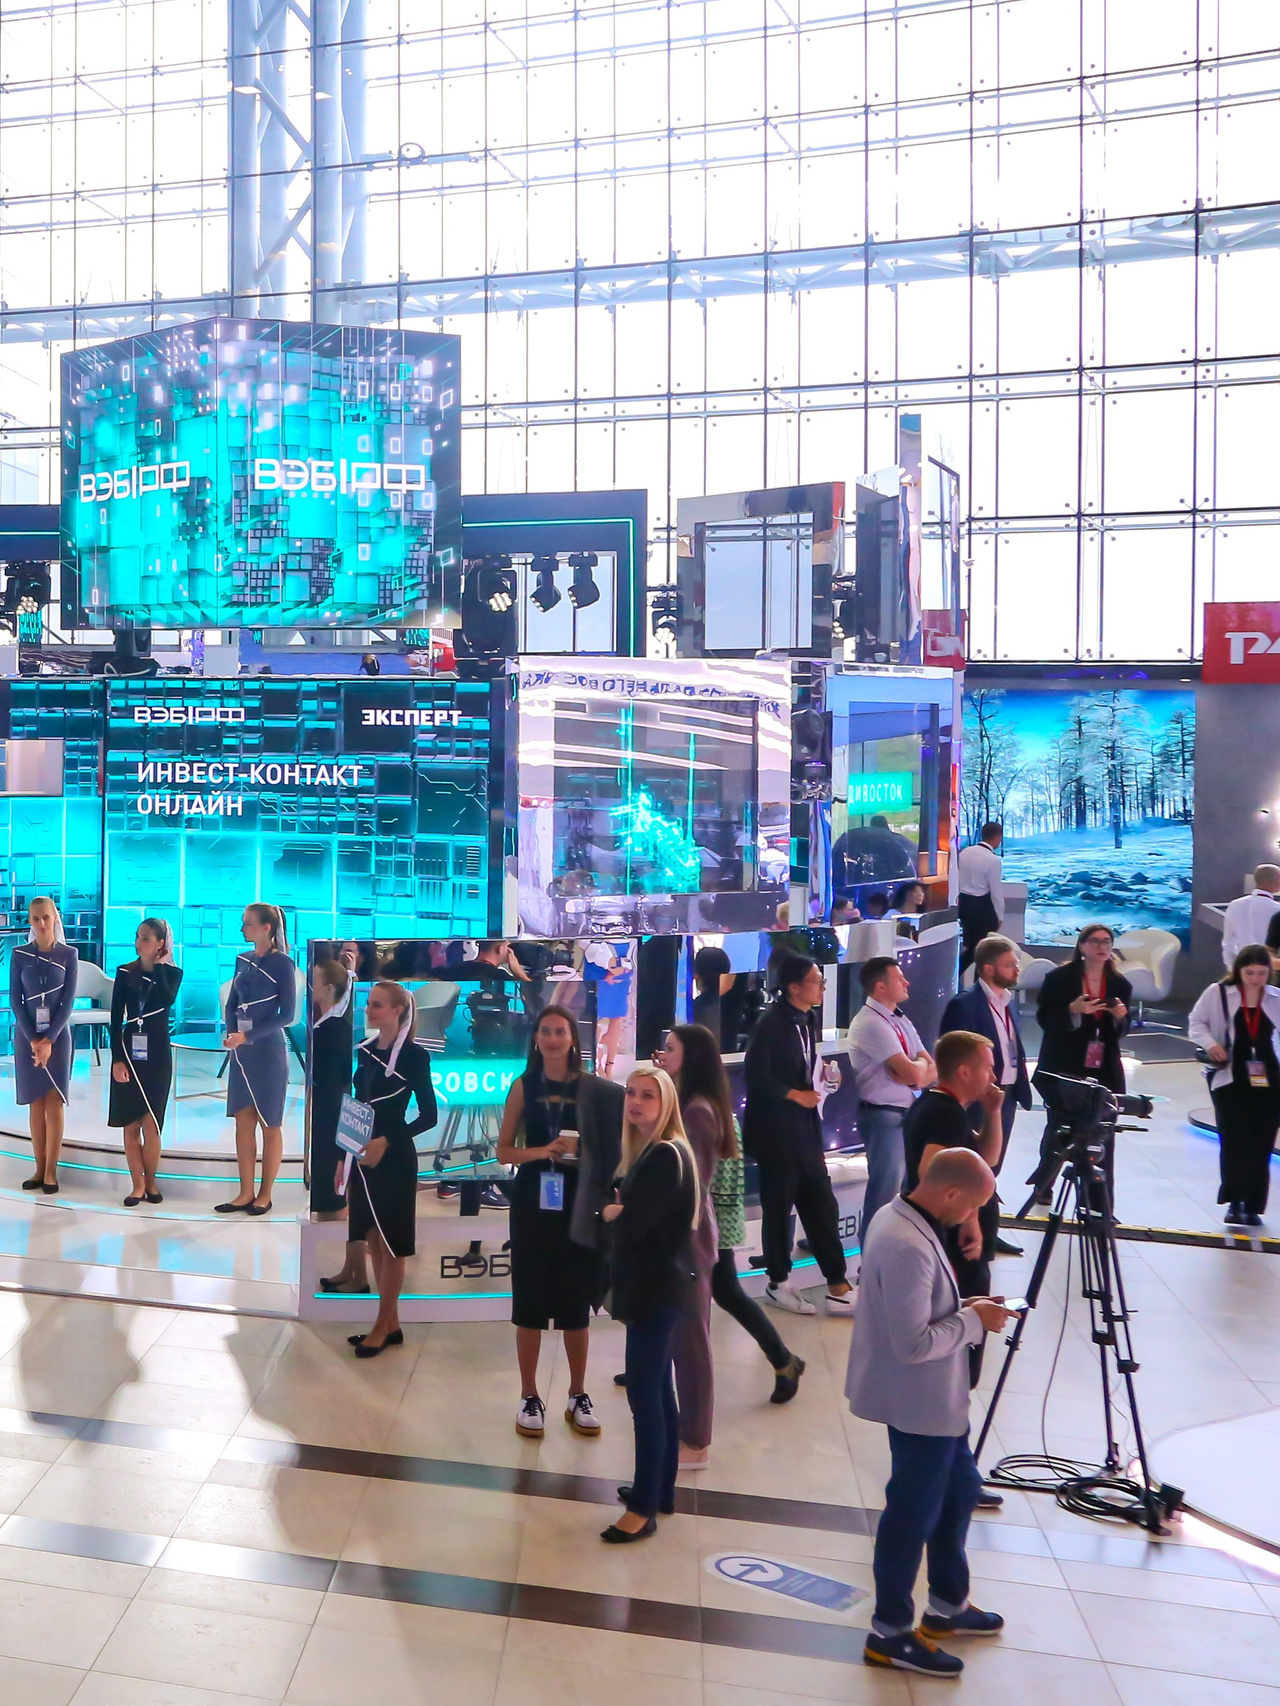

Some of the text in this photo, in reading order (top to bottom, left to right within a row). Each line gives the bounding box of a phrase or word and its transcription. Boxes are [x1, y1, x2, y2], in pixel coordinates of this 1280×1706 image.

[362, 709, 462, 726] ЭКСПЕРТ
[136, 762, 363, 786] ИНВЕСТ-КОНТАКТ
[136, 791, 243, 816] ОНЛАЙН
[847, 783, 903, 808] ДИВОСТОК
[431, 1072, 514, 1092] РОВСК
[340, 1111, 370, 1137] КОНТАКТ
